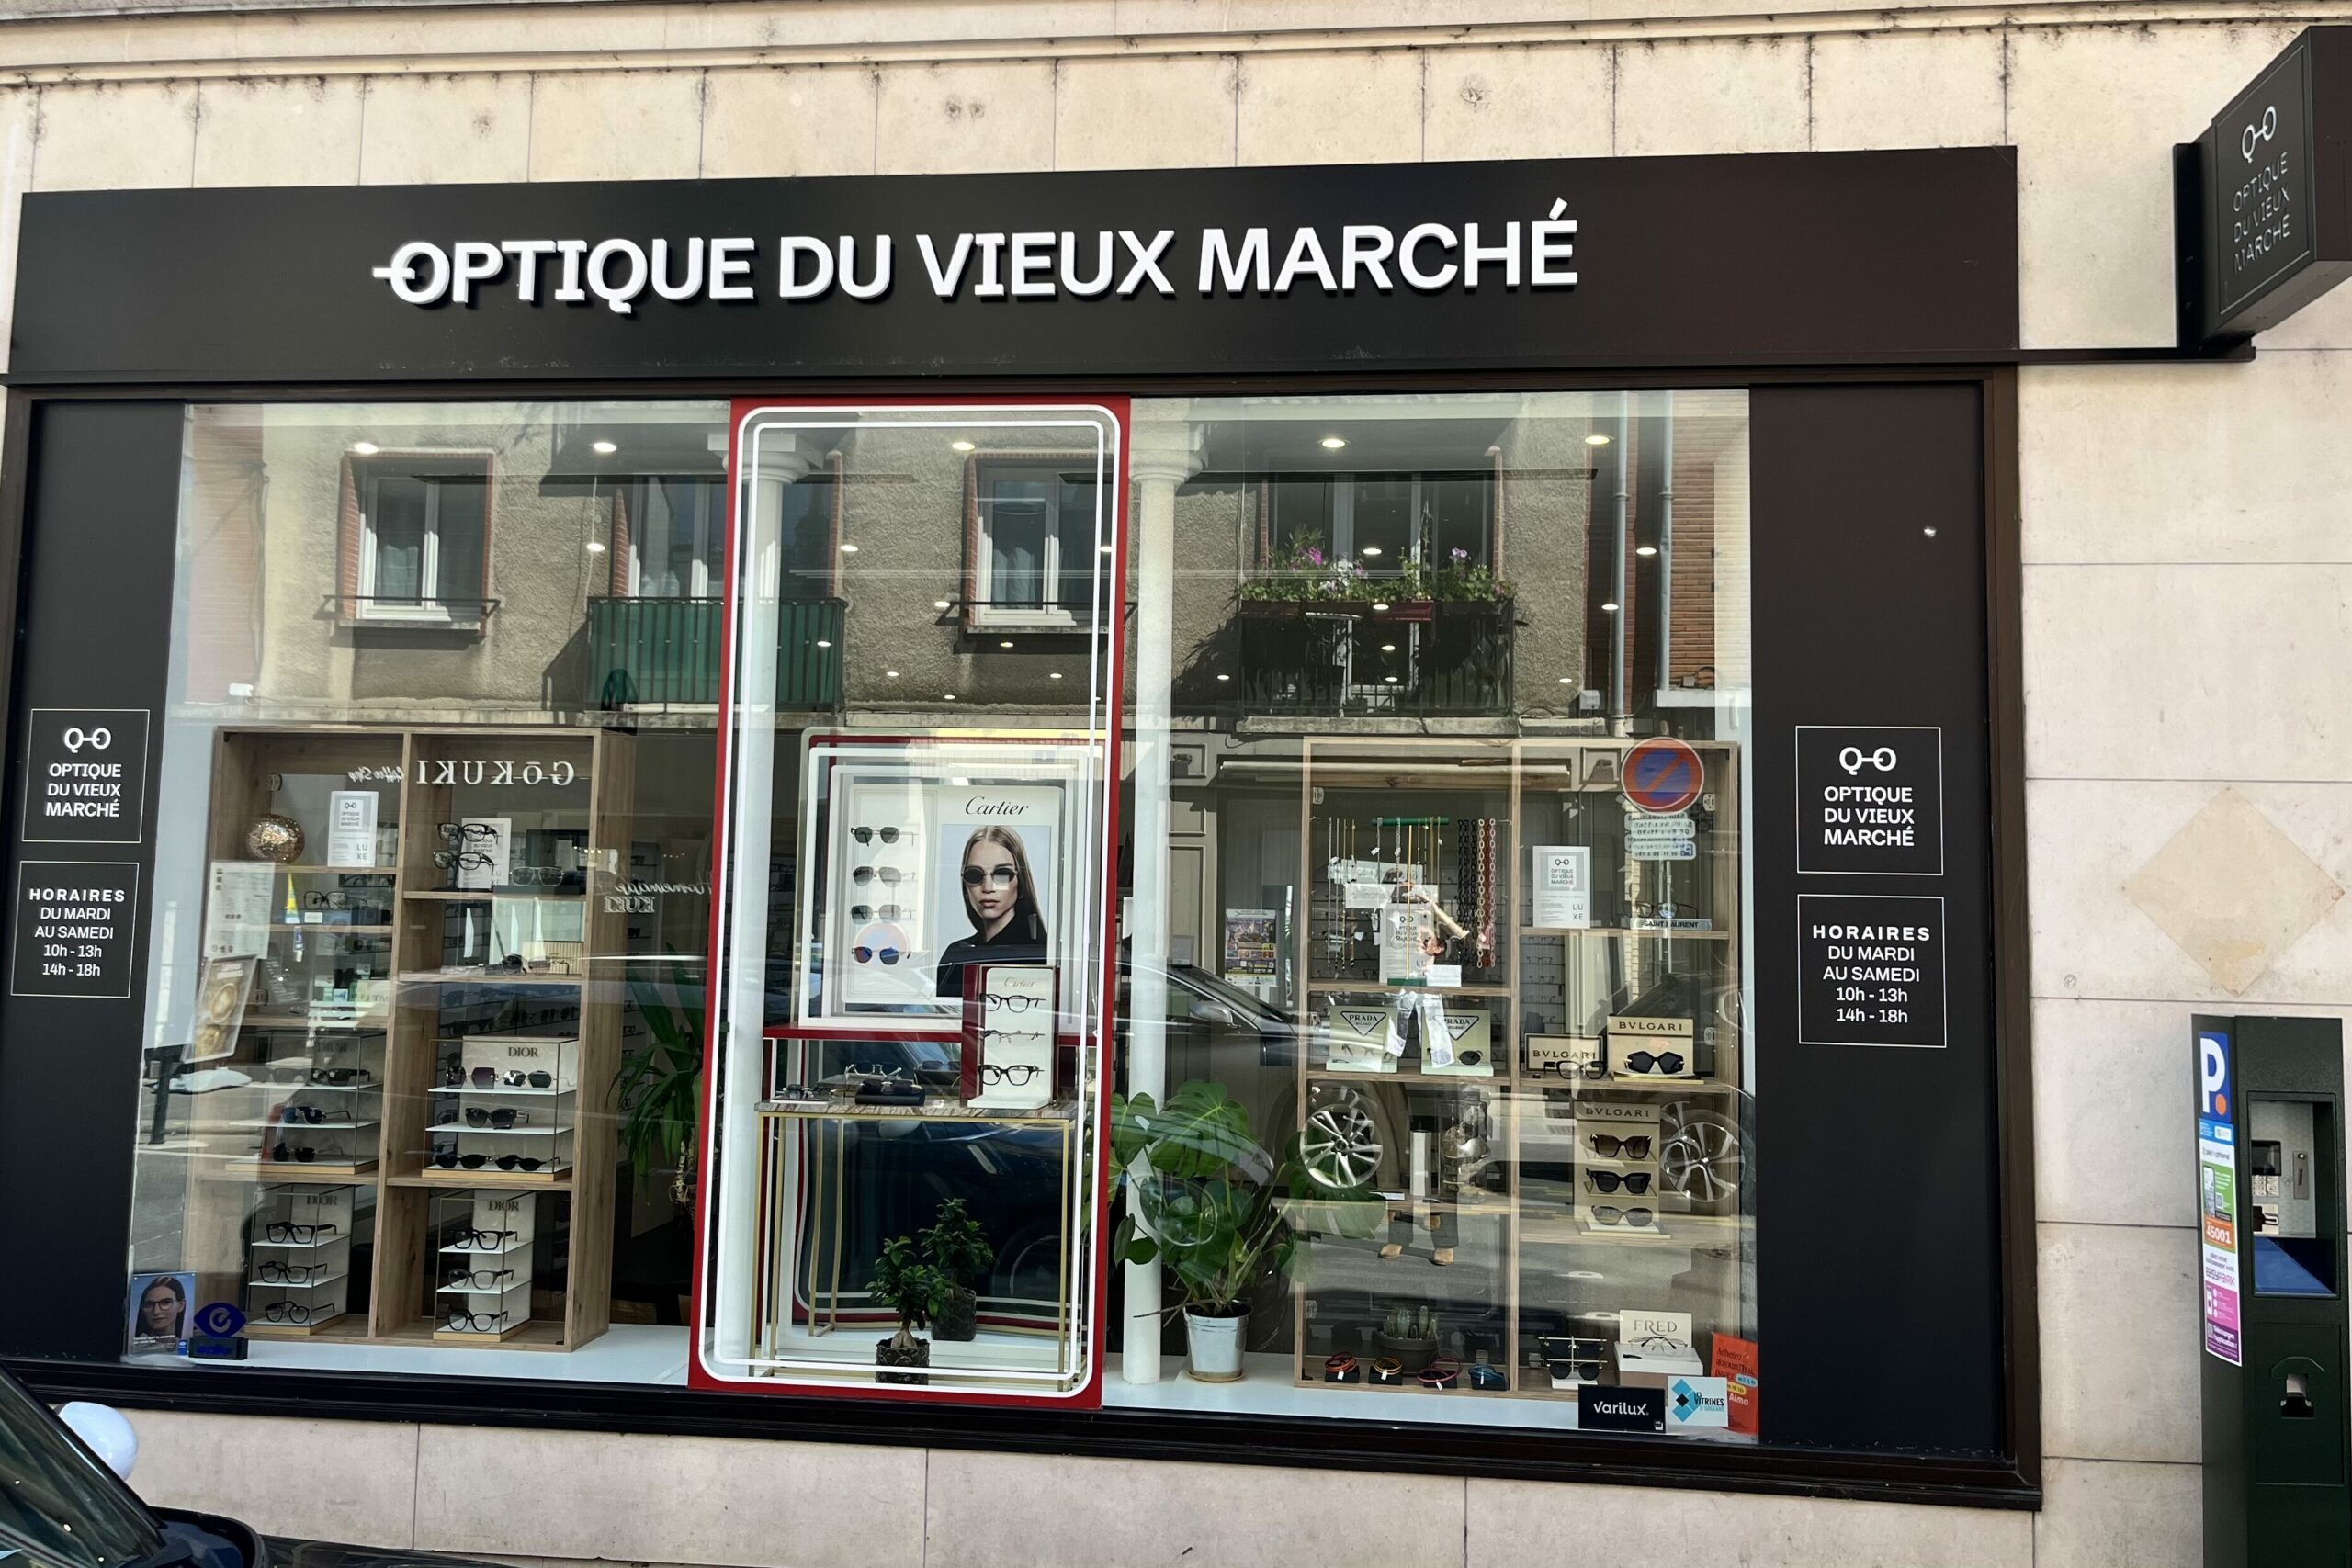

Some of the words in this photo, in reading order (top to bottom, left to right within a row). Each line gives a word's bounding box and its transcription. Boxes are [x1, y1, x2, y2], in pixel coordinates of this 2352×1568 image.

[2233, 151, 2289, 212] OPTIQUE
[2233, 215, 2251, 243] DU
[2253, 186, 2290, 228] VIEUX
[372, 236, 755, 314] OPTIQUE
[779, 234, 892, 300] DU
[915, 229, 1175, 298] VIEUX
[1197, 197, 1579, 293] MARCHÉ
[49, 762, 122, 780] OPTIQUE
[47, 783, 70, 797] DU
[73, 783, 121, 798] VIEUX
[1823, 786, 1913, 806] OPTIQUE
[45, 798, 120, 818] MARCHÉ
[964, 795, 1031, 817] Cartier
[1824, 807, 1851, 824] DU
[1855, 808, 1915, 825] VIEUX
[1823, 825, 1915, 847] MARCHÉ
[28, 887, 125, 903] HORAIRES
[40, 907, 62, 920] DU
[64, 908, 111, 921] MARDI
[34, 925, 55, 939] AU
[57, 926, 114, 940] SAMEDI
[1812, 924, 1931, 942] HORAIRES
[43, 944, 68, 958] 10h
[77, 944, 102, 958] 13h
[1827, 946, 1854, 961] DU
[1857, 946, 1916, 962] MARDI
[41, 963, 66, 976] 14h
[76, 963, 101, 977] 18h
[1822, 965, 1848, 981] AU
[1850, 966, 1921, 983] SAMEDI
[1836, 987, 1866, 1002] 10h
[1878, 987, 1908, 1003] 13h
[1836, 1007, 1866, 1022] 14h
[1878, 1008, 1908, 1023] 18h
[1618, 1021, 1683, 1032] BVLGARI
[508, 1046, 539, 1058] DIOR
[1532, 1049, 1597, 1060] BVLGARI
[1585, 1107, 1650, 1118] BVLGARI
[487, 1201, 520, 1213] DIOR
[2205, 1224, 2233, 1246] 45001
[1634, 1319, 1678, 1336] FRED
[1728, 1393, 1749, 1406] Alma
